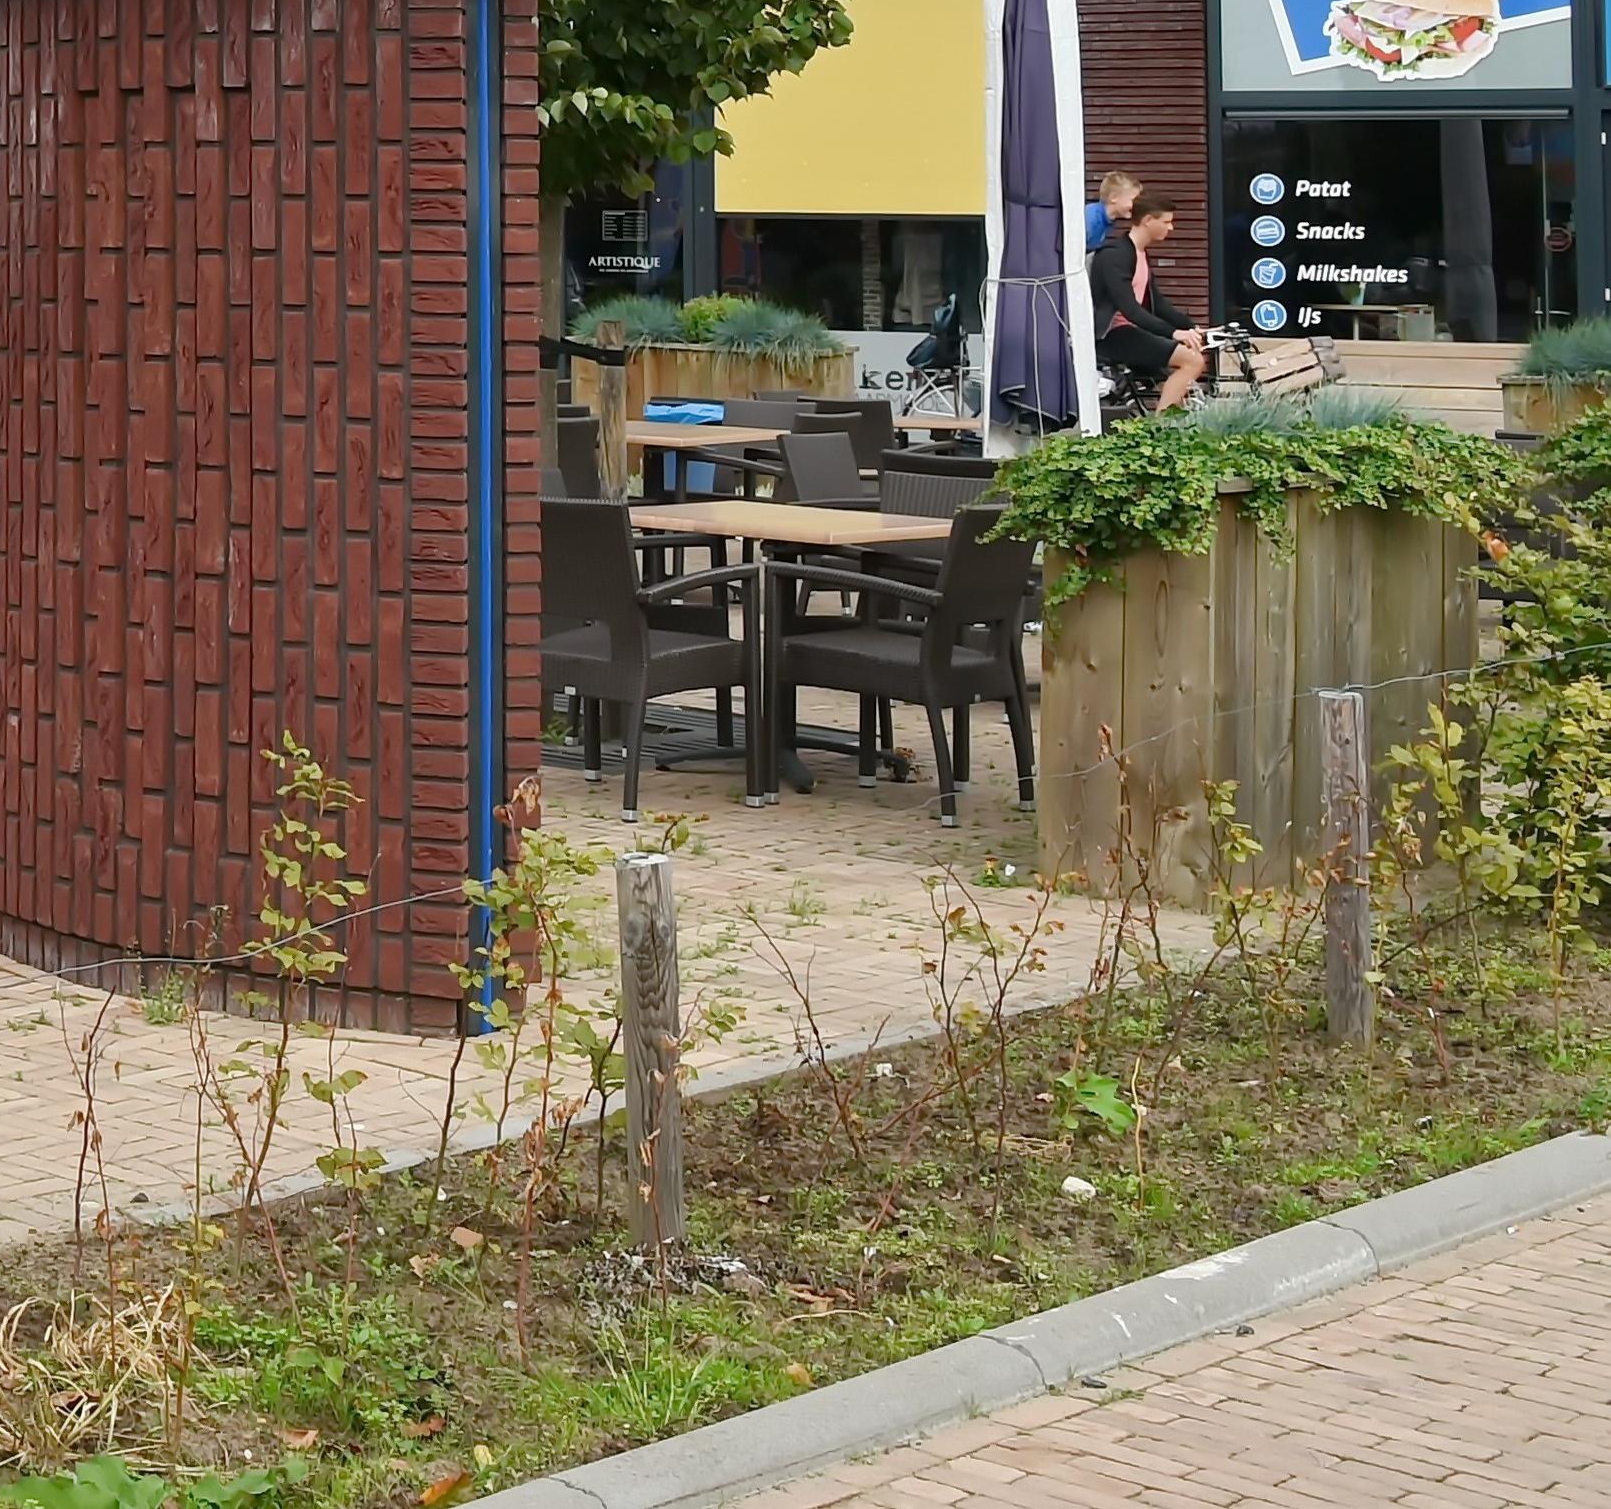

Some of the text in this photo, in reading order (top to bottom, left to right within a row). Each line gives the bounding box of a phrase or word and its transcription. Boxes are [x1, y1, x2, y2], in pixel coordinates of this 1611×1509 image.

[1295, 179, 1352, 197] Patat
[1295, 221, 1366, 240] Snacks
[588, 256, 661, 270] ARTISTIQUE
[1296, 264, 1409, 283] Milkshakes
[1297, 306, 1322, 328] IJs
